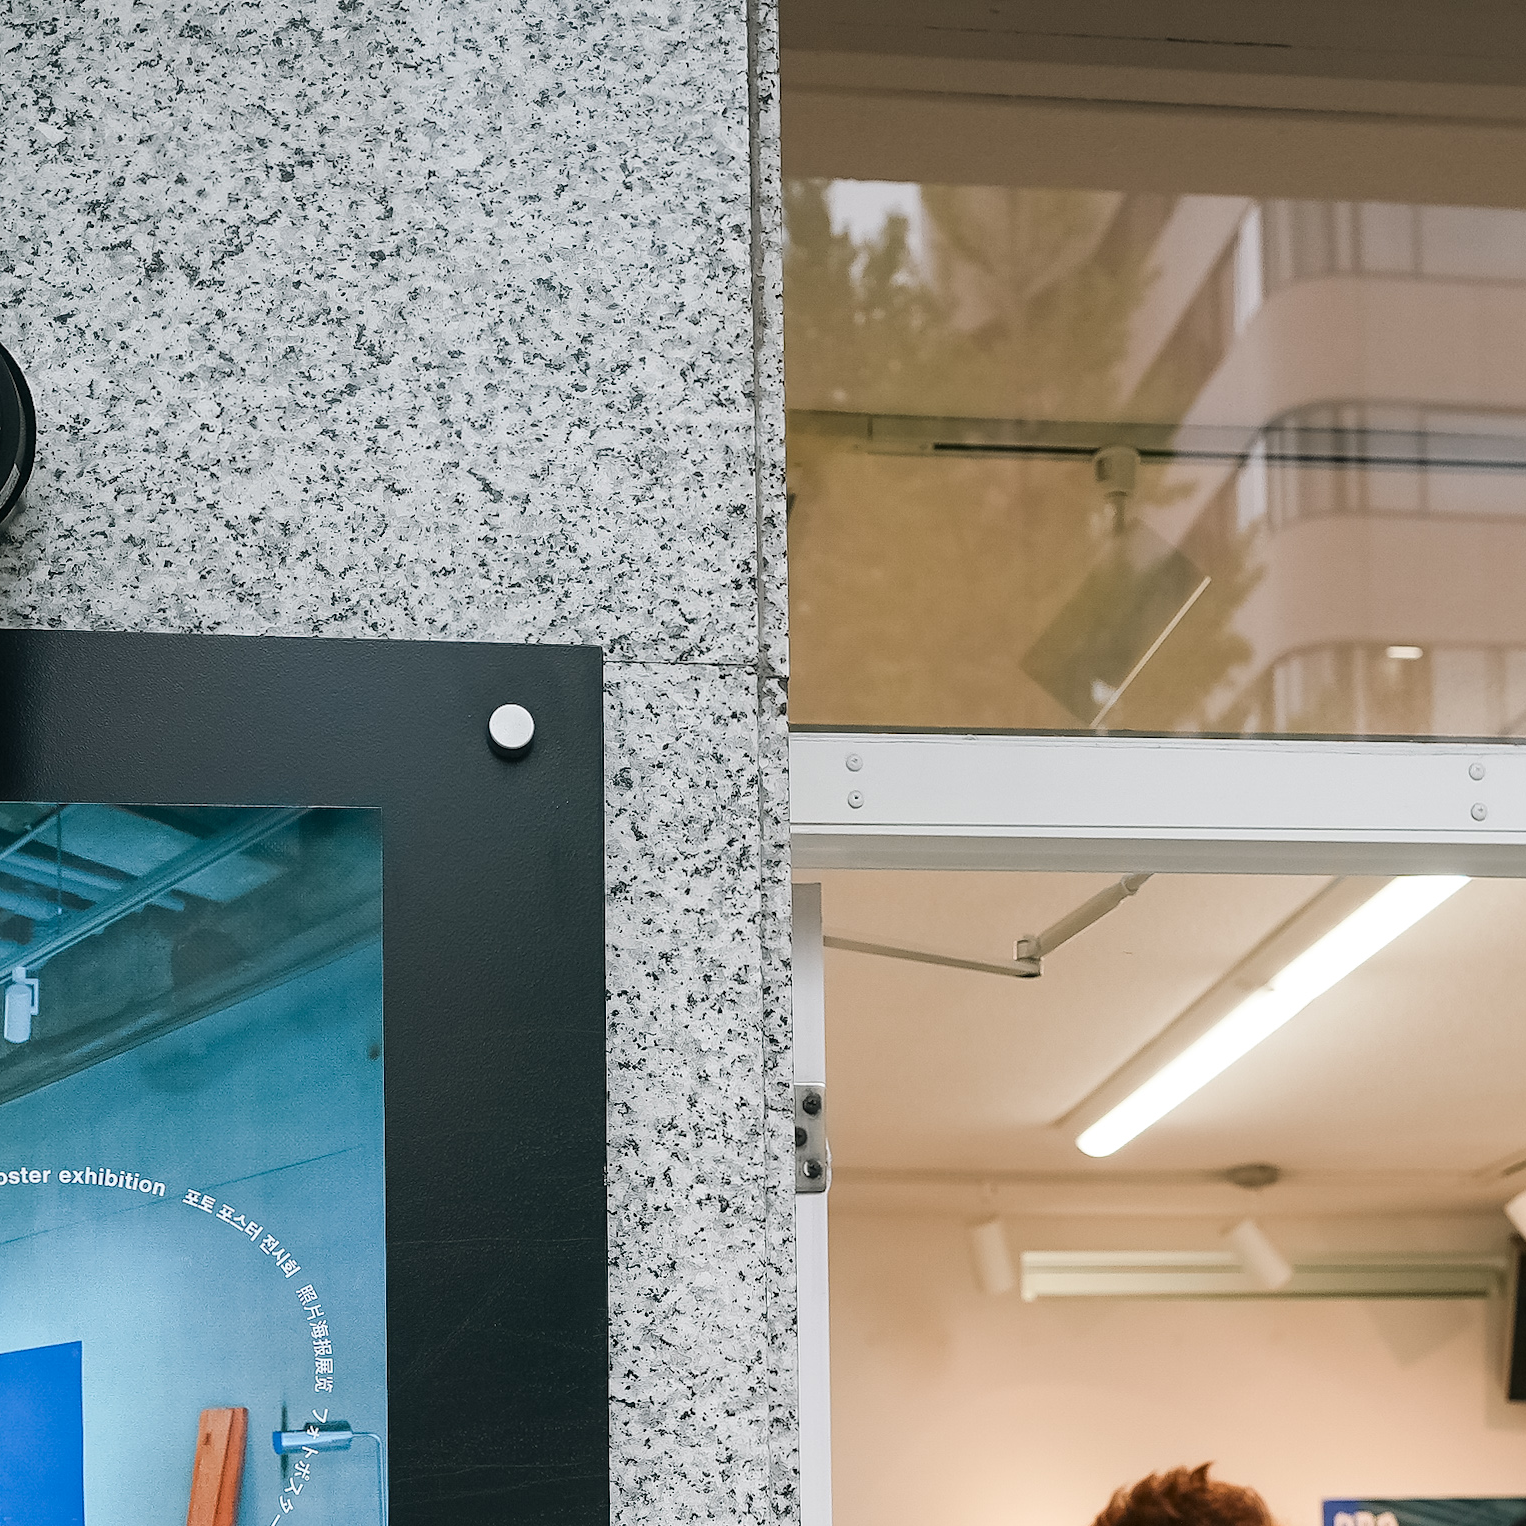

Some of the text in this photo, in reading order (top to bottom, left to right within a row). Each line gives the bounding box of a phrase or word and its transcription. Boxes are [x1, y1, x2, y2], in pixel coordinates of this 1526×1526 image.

[58, 1166, 167, 1198] exhibition
[182, 1187, 302, 1279] 포토 포스터 전시회
[295, 1283, 335, 1393] 照片海报展览
